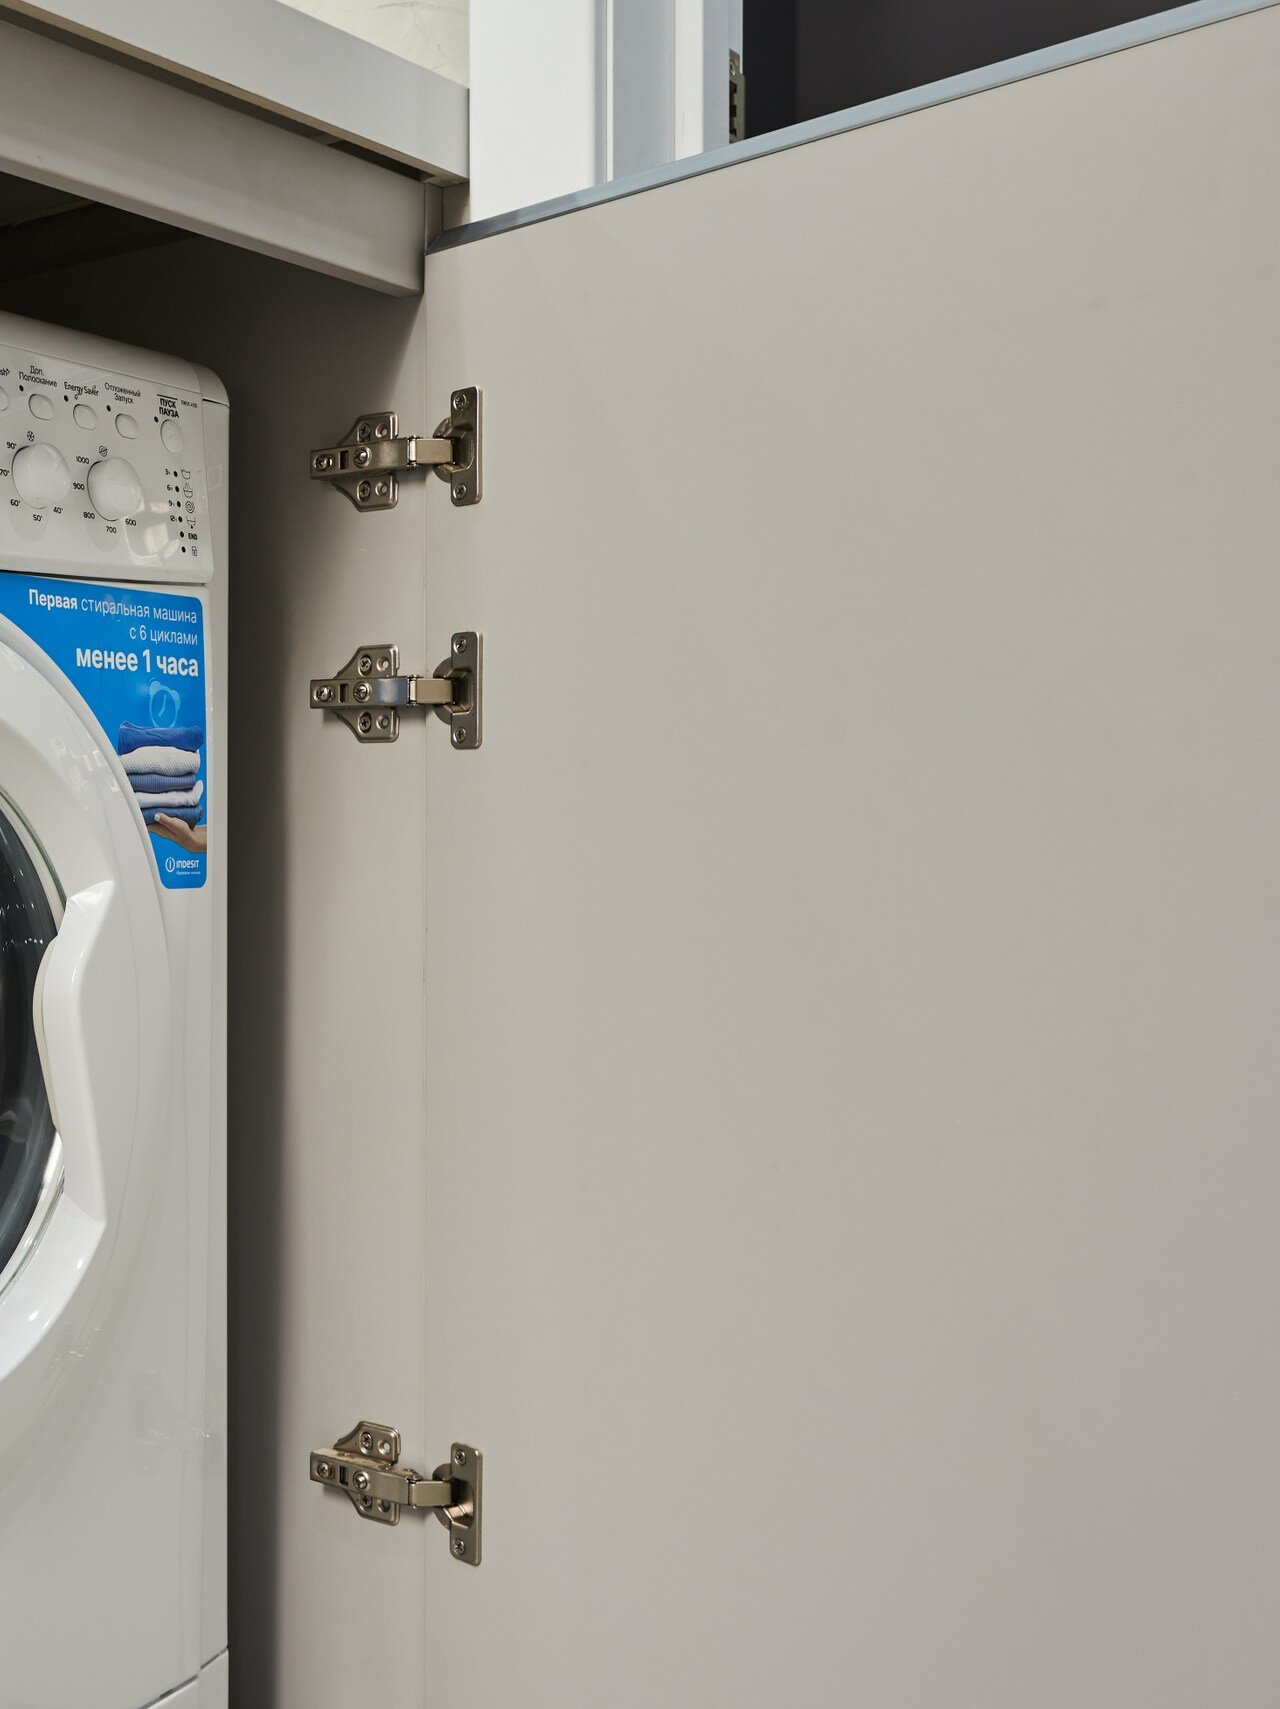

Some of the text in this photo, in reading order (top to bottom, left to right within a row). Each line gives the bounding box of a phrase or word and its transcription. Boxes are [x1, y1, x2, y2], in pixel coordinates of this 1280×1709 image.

[30, 365, 44, 376] Доп.
[19, 371, 58, 387] Полоскание
[64, 381, 83, 395] Energy
[104, 382, 141, 397] Отложенный
[114, 393, 134, 404] Запуск
[160, 398, 177, 409] ПУСК
[159, 407, 179, 419] ПАУЗА
[76, 456, 90, 465] 1000
[73, 482, 85, 490] 900
[83, 511, 95, 520] 800
[125, 518, 137, 526] 600
[106, 525, 117, 534] 700
[187, 532, 198, 540] END
[28, 588, 197, 624] Первая стиральная машина
[129, 625, 198, 646] с 6 циклами
[76, 647, 199, 677] менее 1 часа
